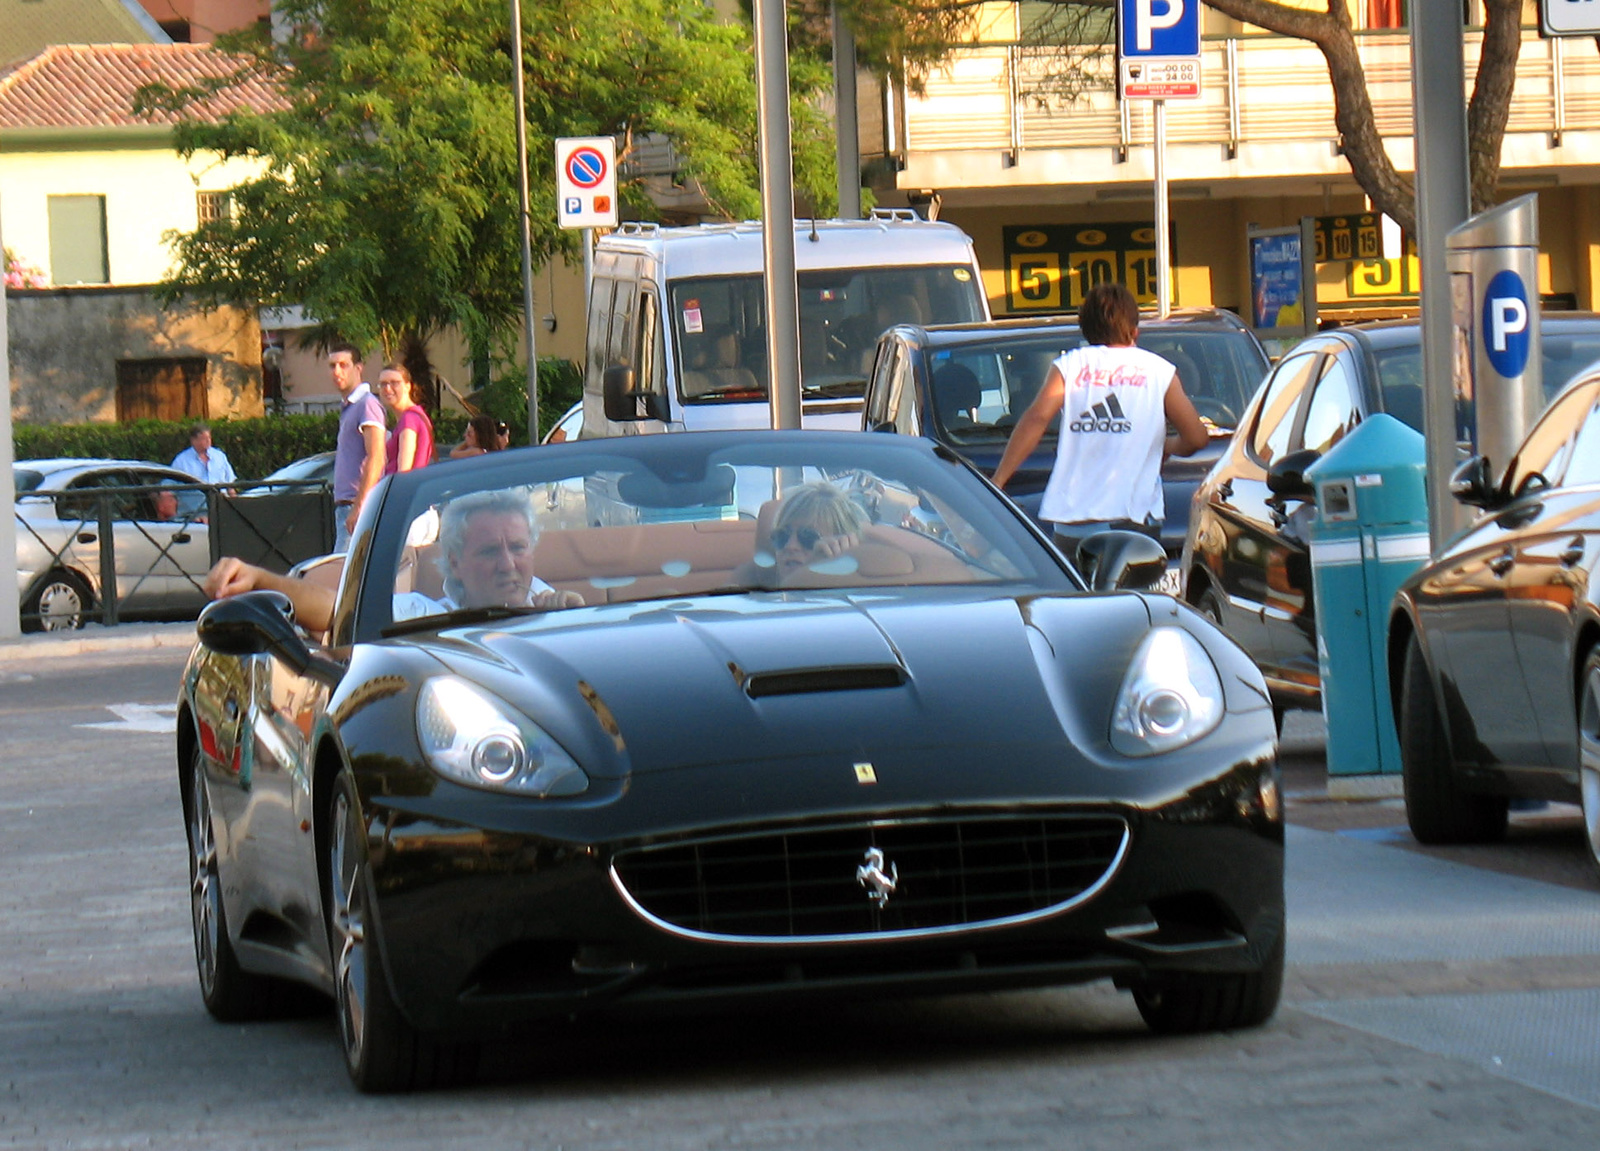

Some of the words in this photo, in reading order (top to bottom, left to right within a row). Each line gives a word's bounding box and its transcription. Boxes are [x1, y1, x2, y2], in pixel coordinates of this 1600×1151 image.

[1136, 0, 1184, 50] P
[568, 198, 580, 213] P
[1335, 234, 1350, 256] 10
[1361, 233, 1375, 253] 15
[1020, 261, 1050, 300] 5
[1491, 297, 1527, 351] P
[1070, 416, 1132, 434] adidas
